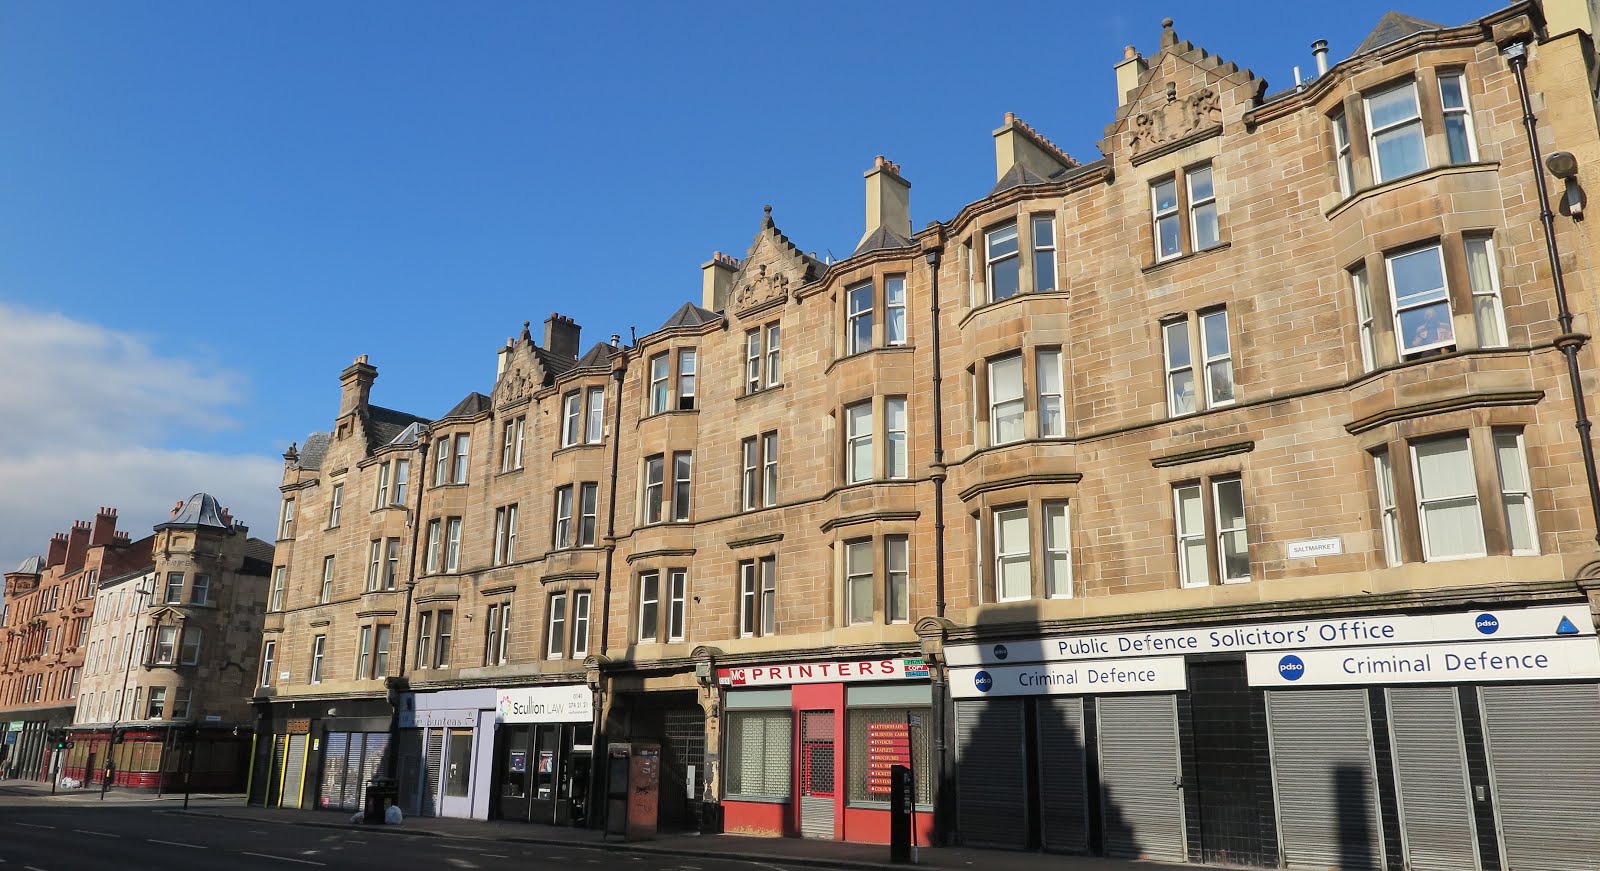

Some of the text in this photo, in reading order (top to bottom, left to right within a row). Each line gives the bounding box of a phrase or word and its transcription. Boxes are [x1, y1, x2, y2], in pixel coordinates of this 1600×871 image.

[1293, 543, 1335, 553] SALTMARKET
[1476, 617, 1498, 629] pdso
[1058, 638, 1108, 655] Public
[1119, 634, 1198, 652] Defence
[1319, 621, 1395, 641] Office
[731, 669, 745, 681] MC
[752, 660, 895, 680] PRINTERS
[1279, 661, 1303, 674] pdso
[1342, 651, 1549, 674] Criminal Defence
[976, 677, 992, 686] pdso
[1019, 668, 1156, 687] Criminal Defence
[513, 696, 564, 714] Scullion LAW
